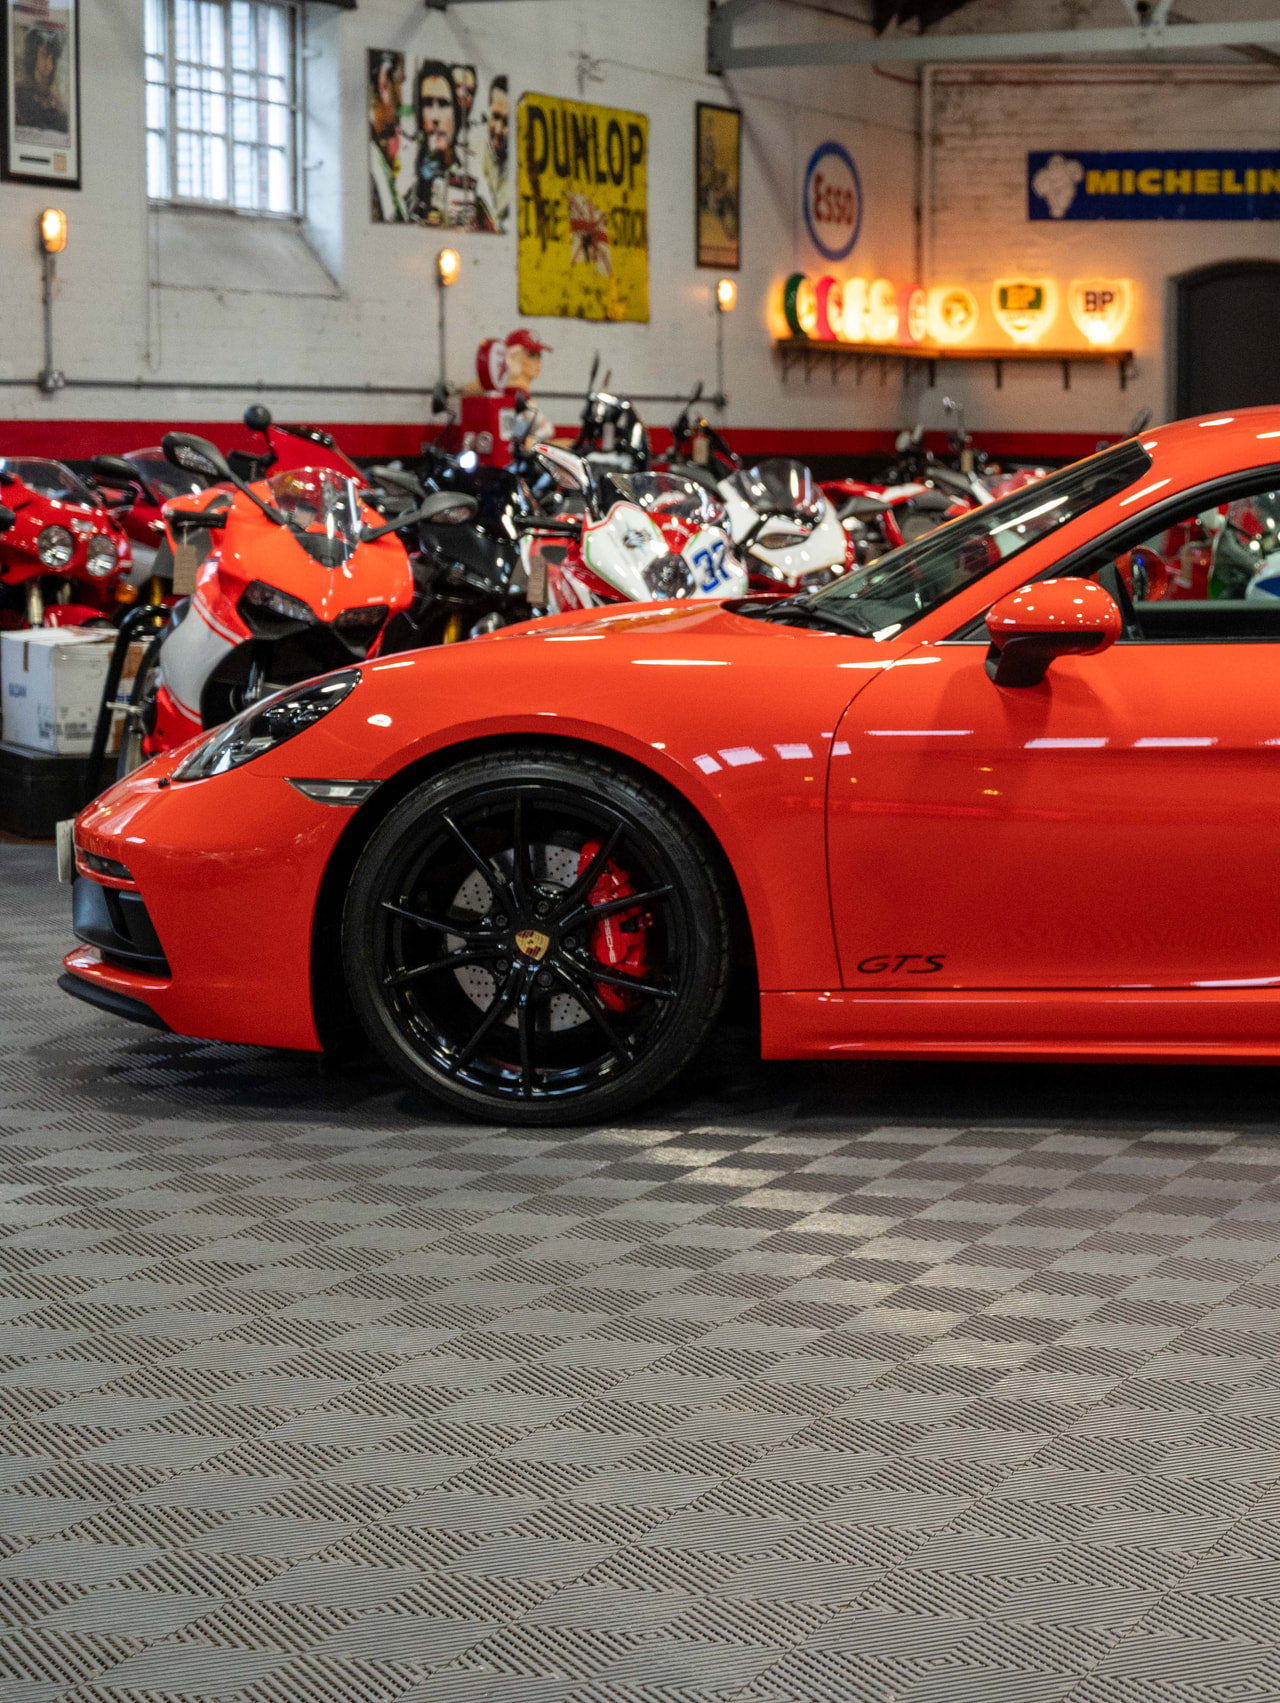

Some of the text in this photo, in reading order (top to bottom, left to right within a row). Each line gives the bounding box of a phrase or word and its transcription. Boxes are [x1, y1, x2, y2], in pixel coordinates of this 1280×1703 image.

[525, 105, 644, 191] DUNLOP
[814, 173, 855, 225] Esso
[1006, 287, 1037, 309] BP
[1085, 290, 1114, 312] BP
[857, 953, 947, 974] GTS
